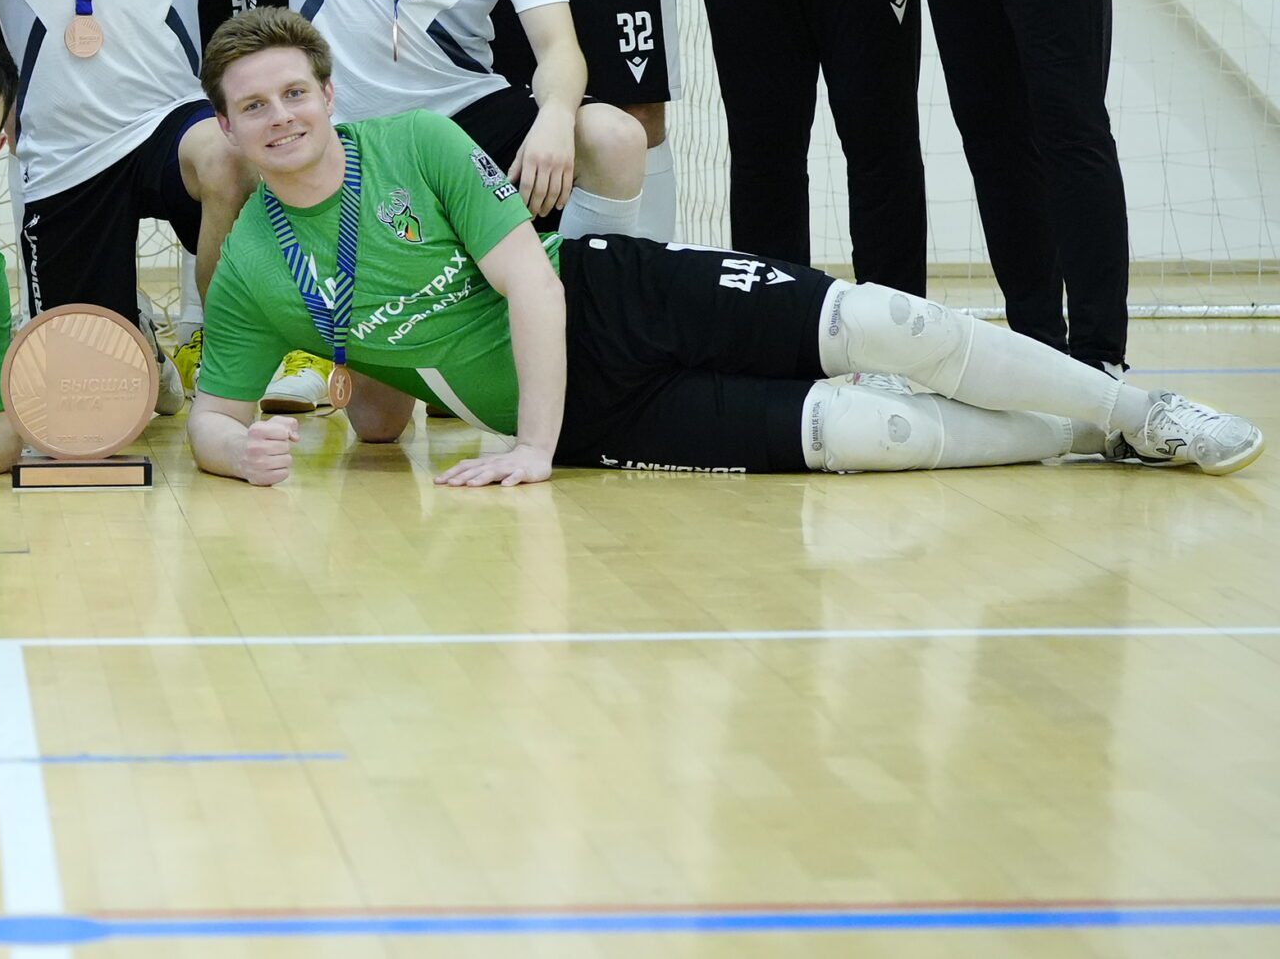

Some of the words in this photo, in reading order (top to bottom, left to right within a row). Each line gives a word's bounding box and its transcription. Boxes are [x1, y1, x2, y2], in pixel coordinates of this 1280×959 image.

[616, 11, 654, 53] 32
[719, 258, 766, 292] 44
[61, 378, 141, 392] ВЫСШАЯ
